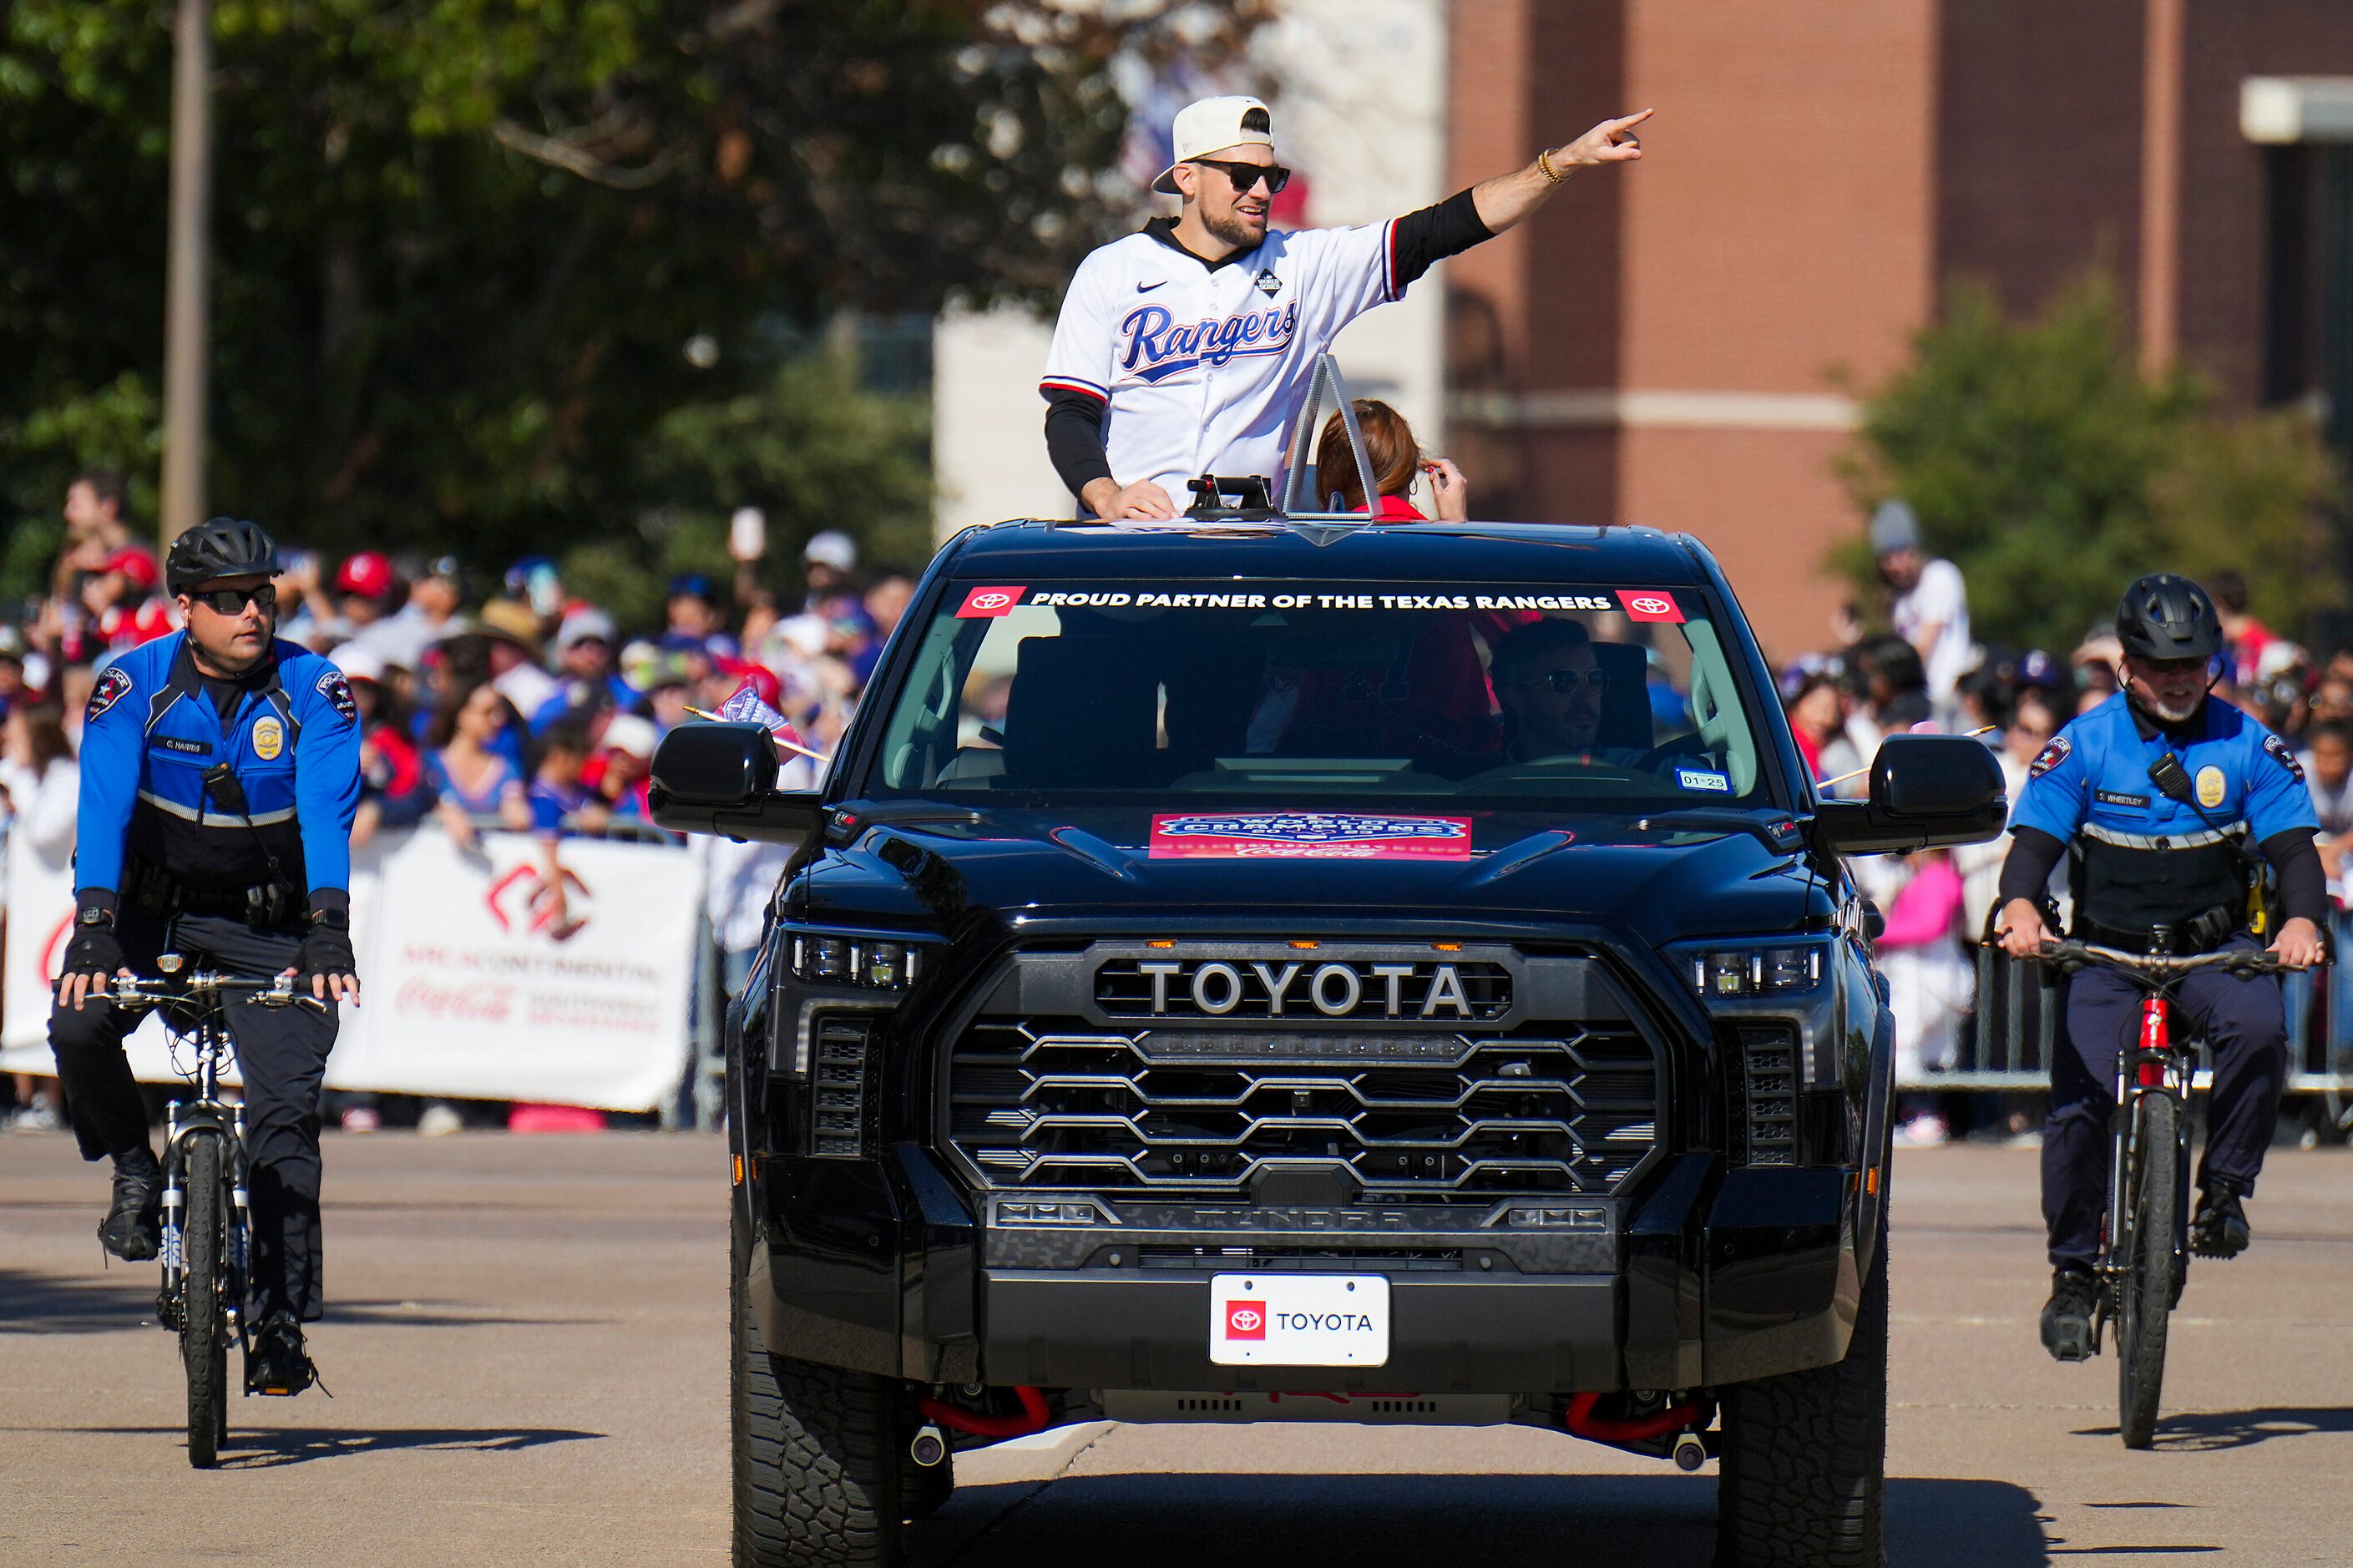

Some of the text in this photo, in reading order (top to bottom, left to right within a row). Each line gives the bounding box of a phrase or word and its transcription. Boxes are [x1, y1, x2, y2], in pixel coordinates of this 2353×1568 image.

[1120, 300, 1297, 374] Rangers
[1030, 593, 1612, 609] PROUD PARTNER OF THE TEXAS RANGERS
[99, 670, 128, 688] POLICE
[166, 740, 200, 752] C. HARRIS
[2107, 794, 2143, 807] WHEETLEY
[1183, 823, 1444, 833] CHAMPIONS
[1138, 962, 1474, 1018] TOYOTA
[1276, 1313, 1373, 1331] TOYOTA
